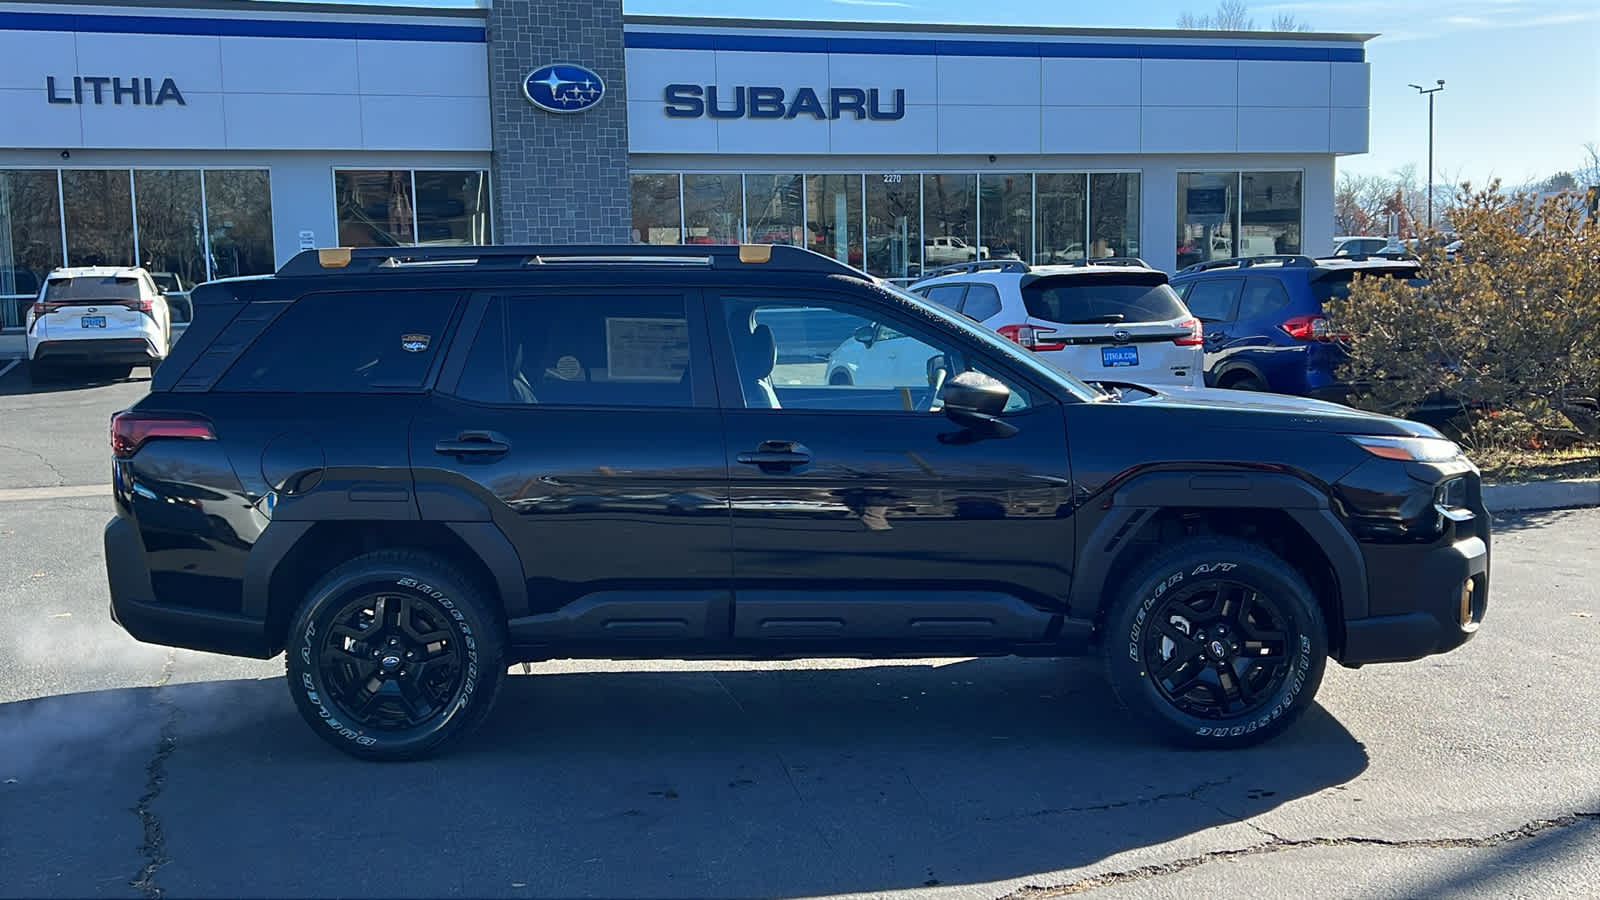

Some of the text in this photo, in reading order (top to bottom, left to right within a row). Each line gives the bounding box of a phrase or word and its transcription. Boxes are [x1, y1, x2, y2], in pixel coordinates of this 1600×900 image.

[46, 76, 187, 105] LITHIA
[664, 84, 905, 120] SUBARU
[883, 174, 901, 183] 2270
[397, 577, 478, 709] BRIDGESTONE
[1129, 562, 1237, 662] DUELER A/T
[301, 620, 377, 746] DUELER A/T
[1196, 633, 1312, 737] BRIDGESTONE
